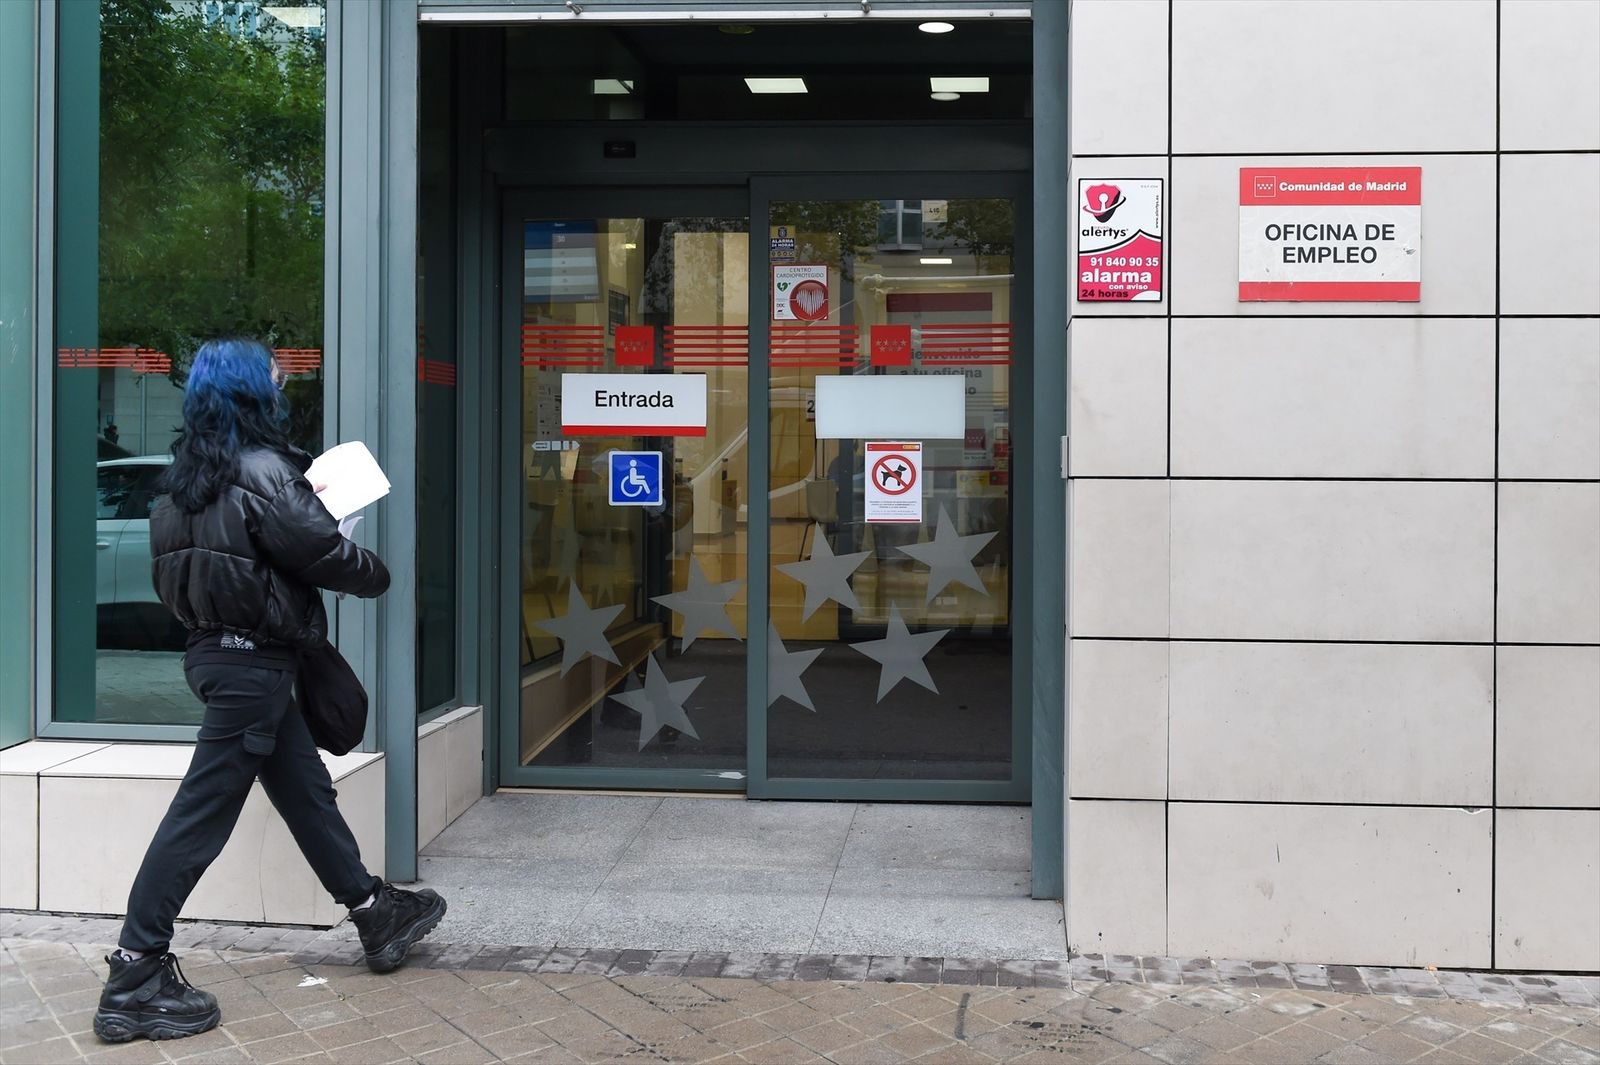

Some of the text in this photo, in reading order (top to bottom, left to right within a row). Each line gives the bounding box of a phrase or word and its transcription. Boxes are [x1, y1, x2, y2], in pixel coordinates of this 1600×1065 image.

[1279, 181, 1407, 192] Comunidad de Madrid
[1081, 226, 1127, 239] alertys
[1265, 223, 1395, 242] OFICINA DE
[1090, 257, 1159, 267] 91 840 90 35
[1282, 246, 1378, 264] EMPLEO
[1081, 268, 1152, 283] alarma
[1081, 289, 1129, 298] 24 horas
[595, 389, 675, 408] Entrada
